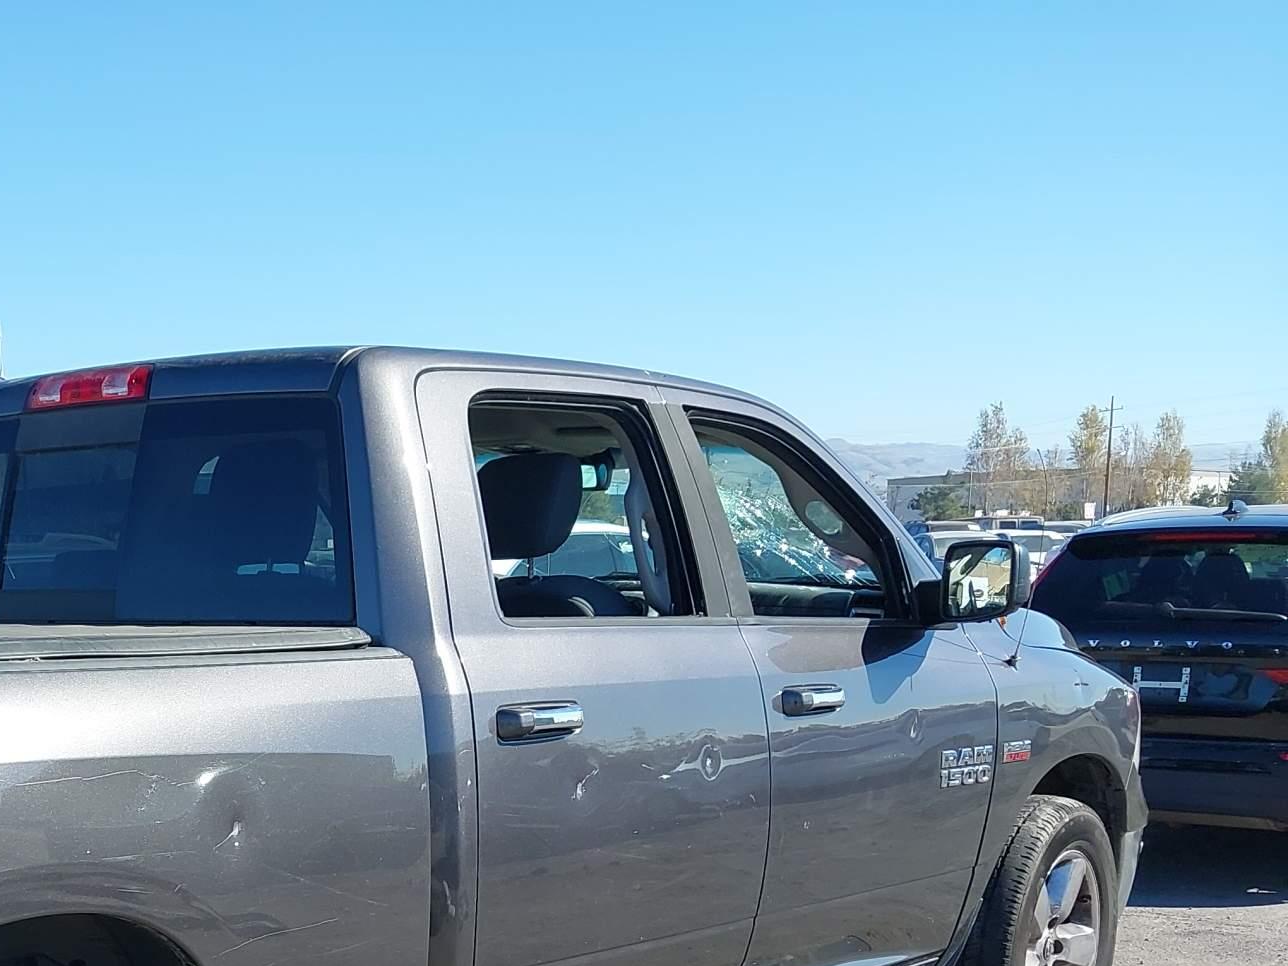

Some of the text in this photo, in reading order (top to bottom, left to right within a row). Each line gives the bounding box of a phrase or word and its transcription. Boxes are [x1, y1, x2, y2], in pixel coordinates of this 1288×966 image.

[1087, 638, 1233, 651] VOLVO
[941, 745, 993, 768] RAM
[940, 765, 992, 789] 1500
